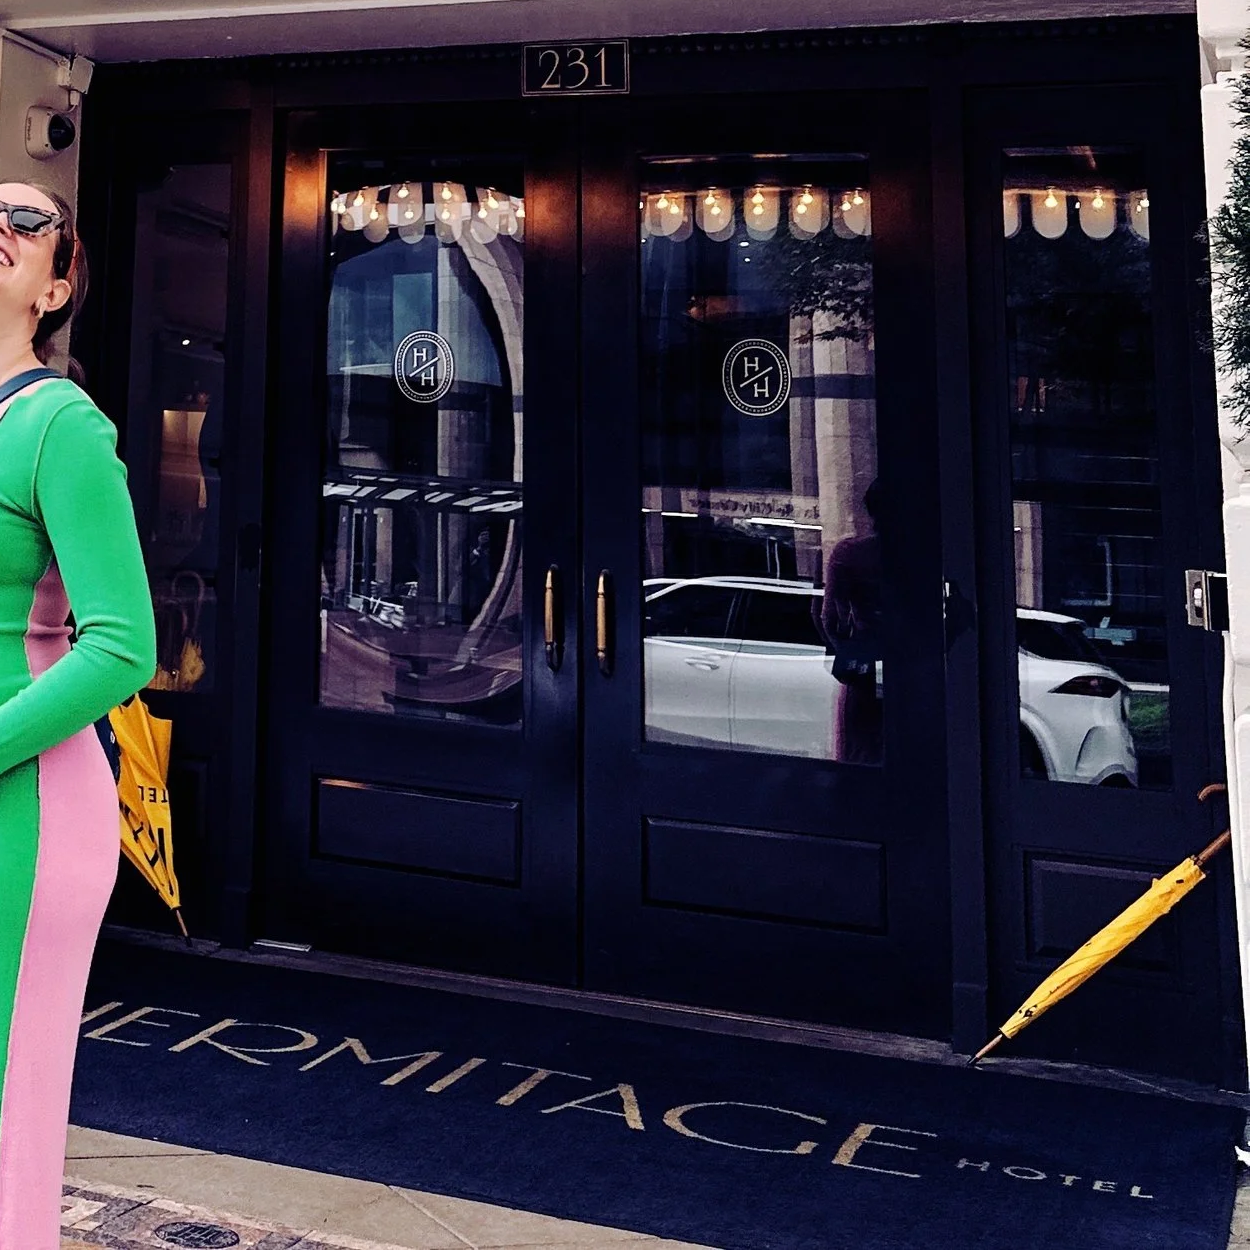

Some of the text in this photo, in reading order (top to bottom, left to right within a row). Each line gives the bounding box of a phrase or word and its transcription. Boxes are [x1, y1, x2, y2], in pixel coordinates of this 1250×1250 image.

[539, 47, 612, 89] 231
[138, 785, 167, 803] TEL
[956, 1157, 1153, 1199] HOTEL
